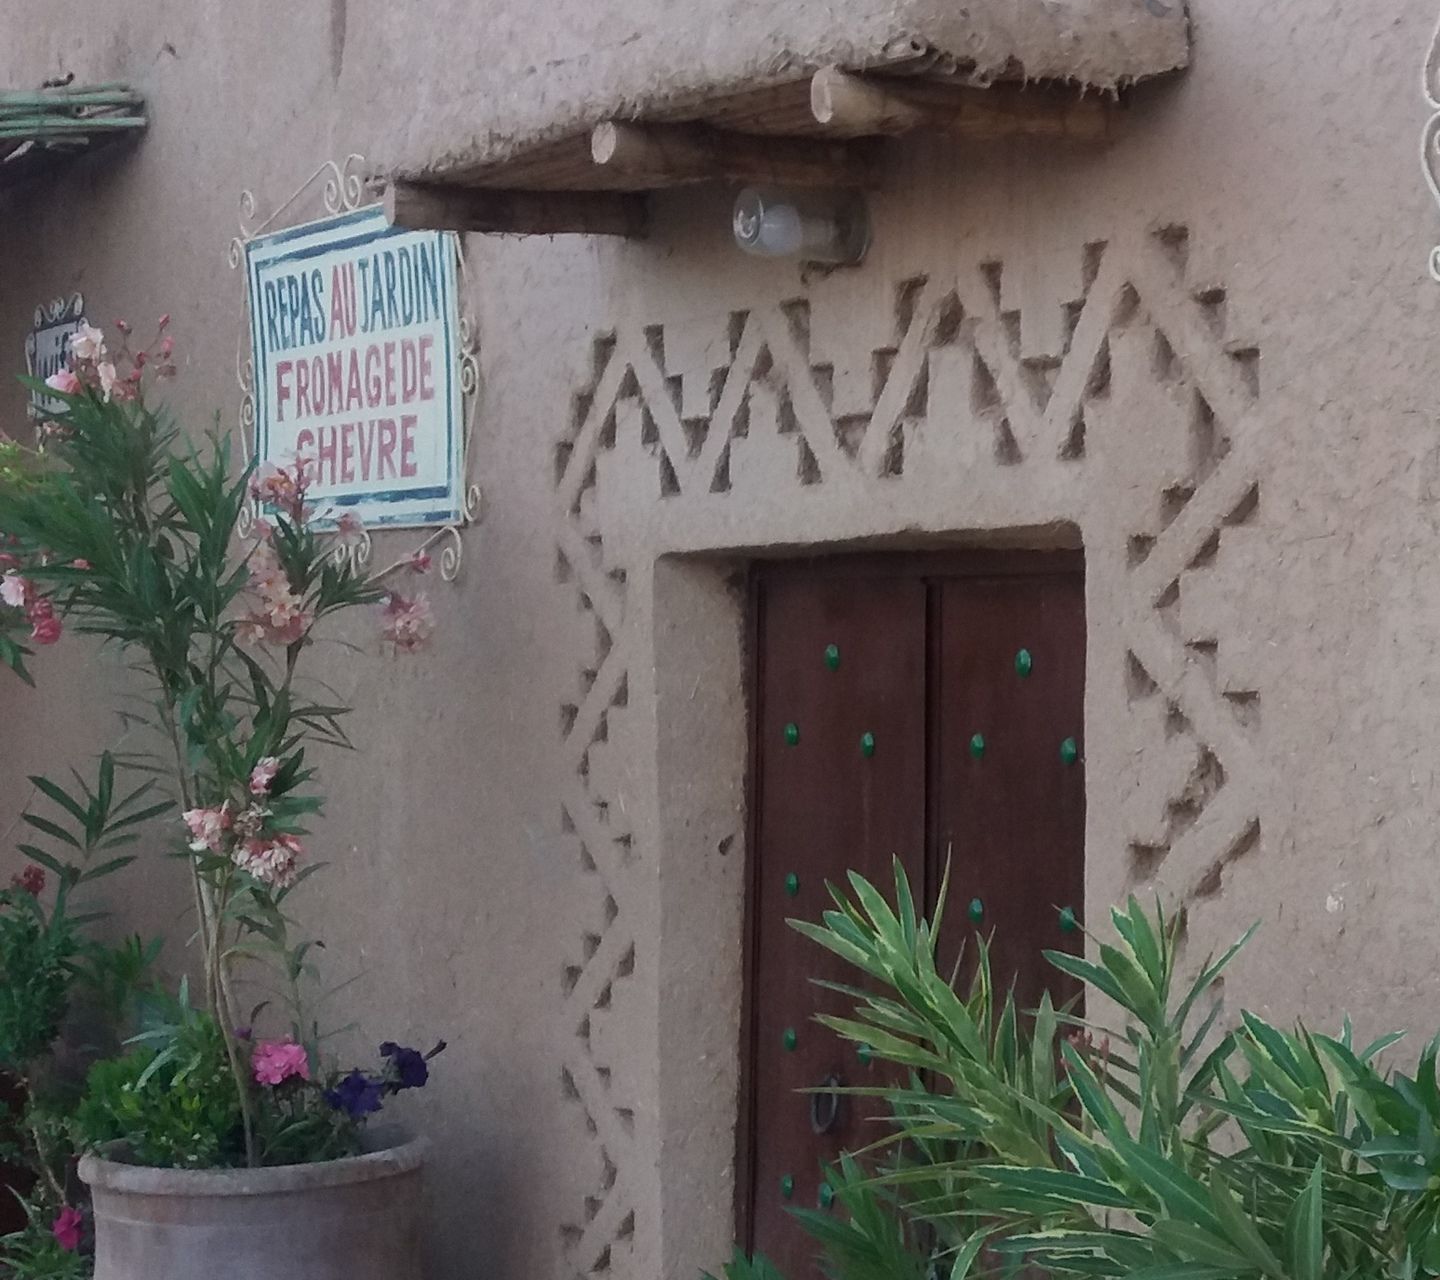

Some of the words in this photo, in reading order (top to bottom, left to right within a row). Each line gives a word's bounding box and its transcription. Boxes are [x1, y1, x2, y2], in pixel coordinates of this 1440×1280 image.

[264, 267, 325, 352] REPAS
[329, 260, 358, 341] AU
[358, 240, 441, 334] JARDIN
[275, 340, 398, 422] FROMAGE
[401, 334, 435, 406] DE
